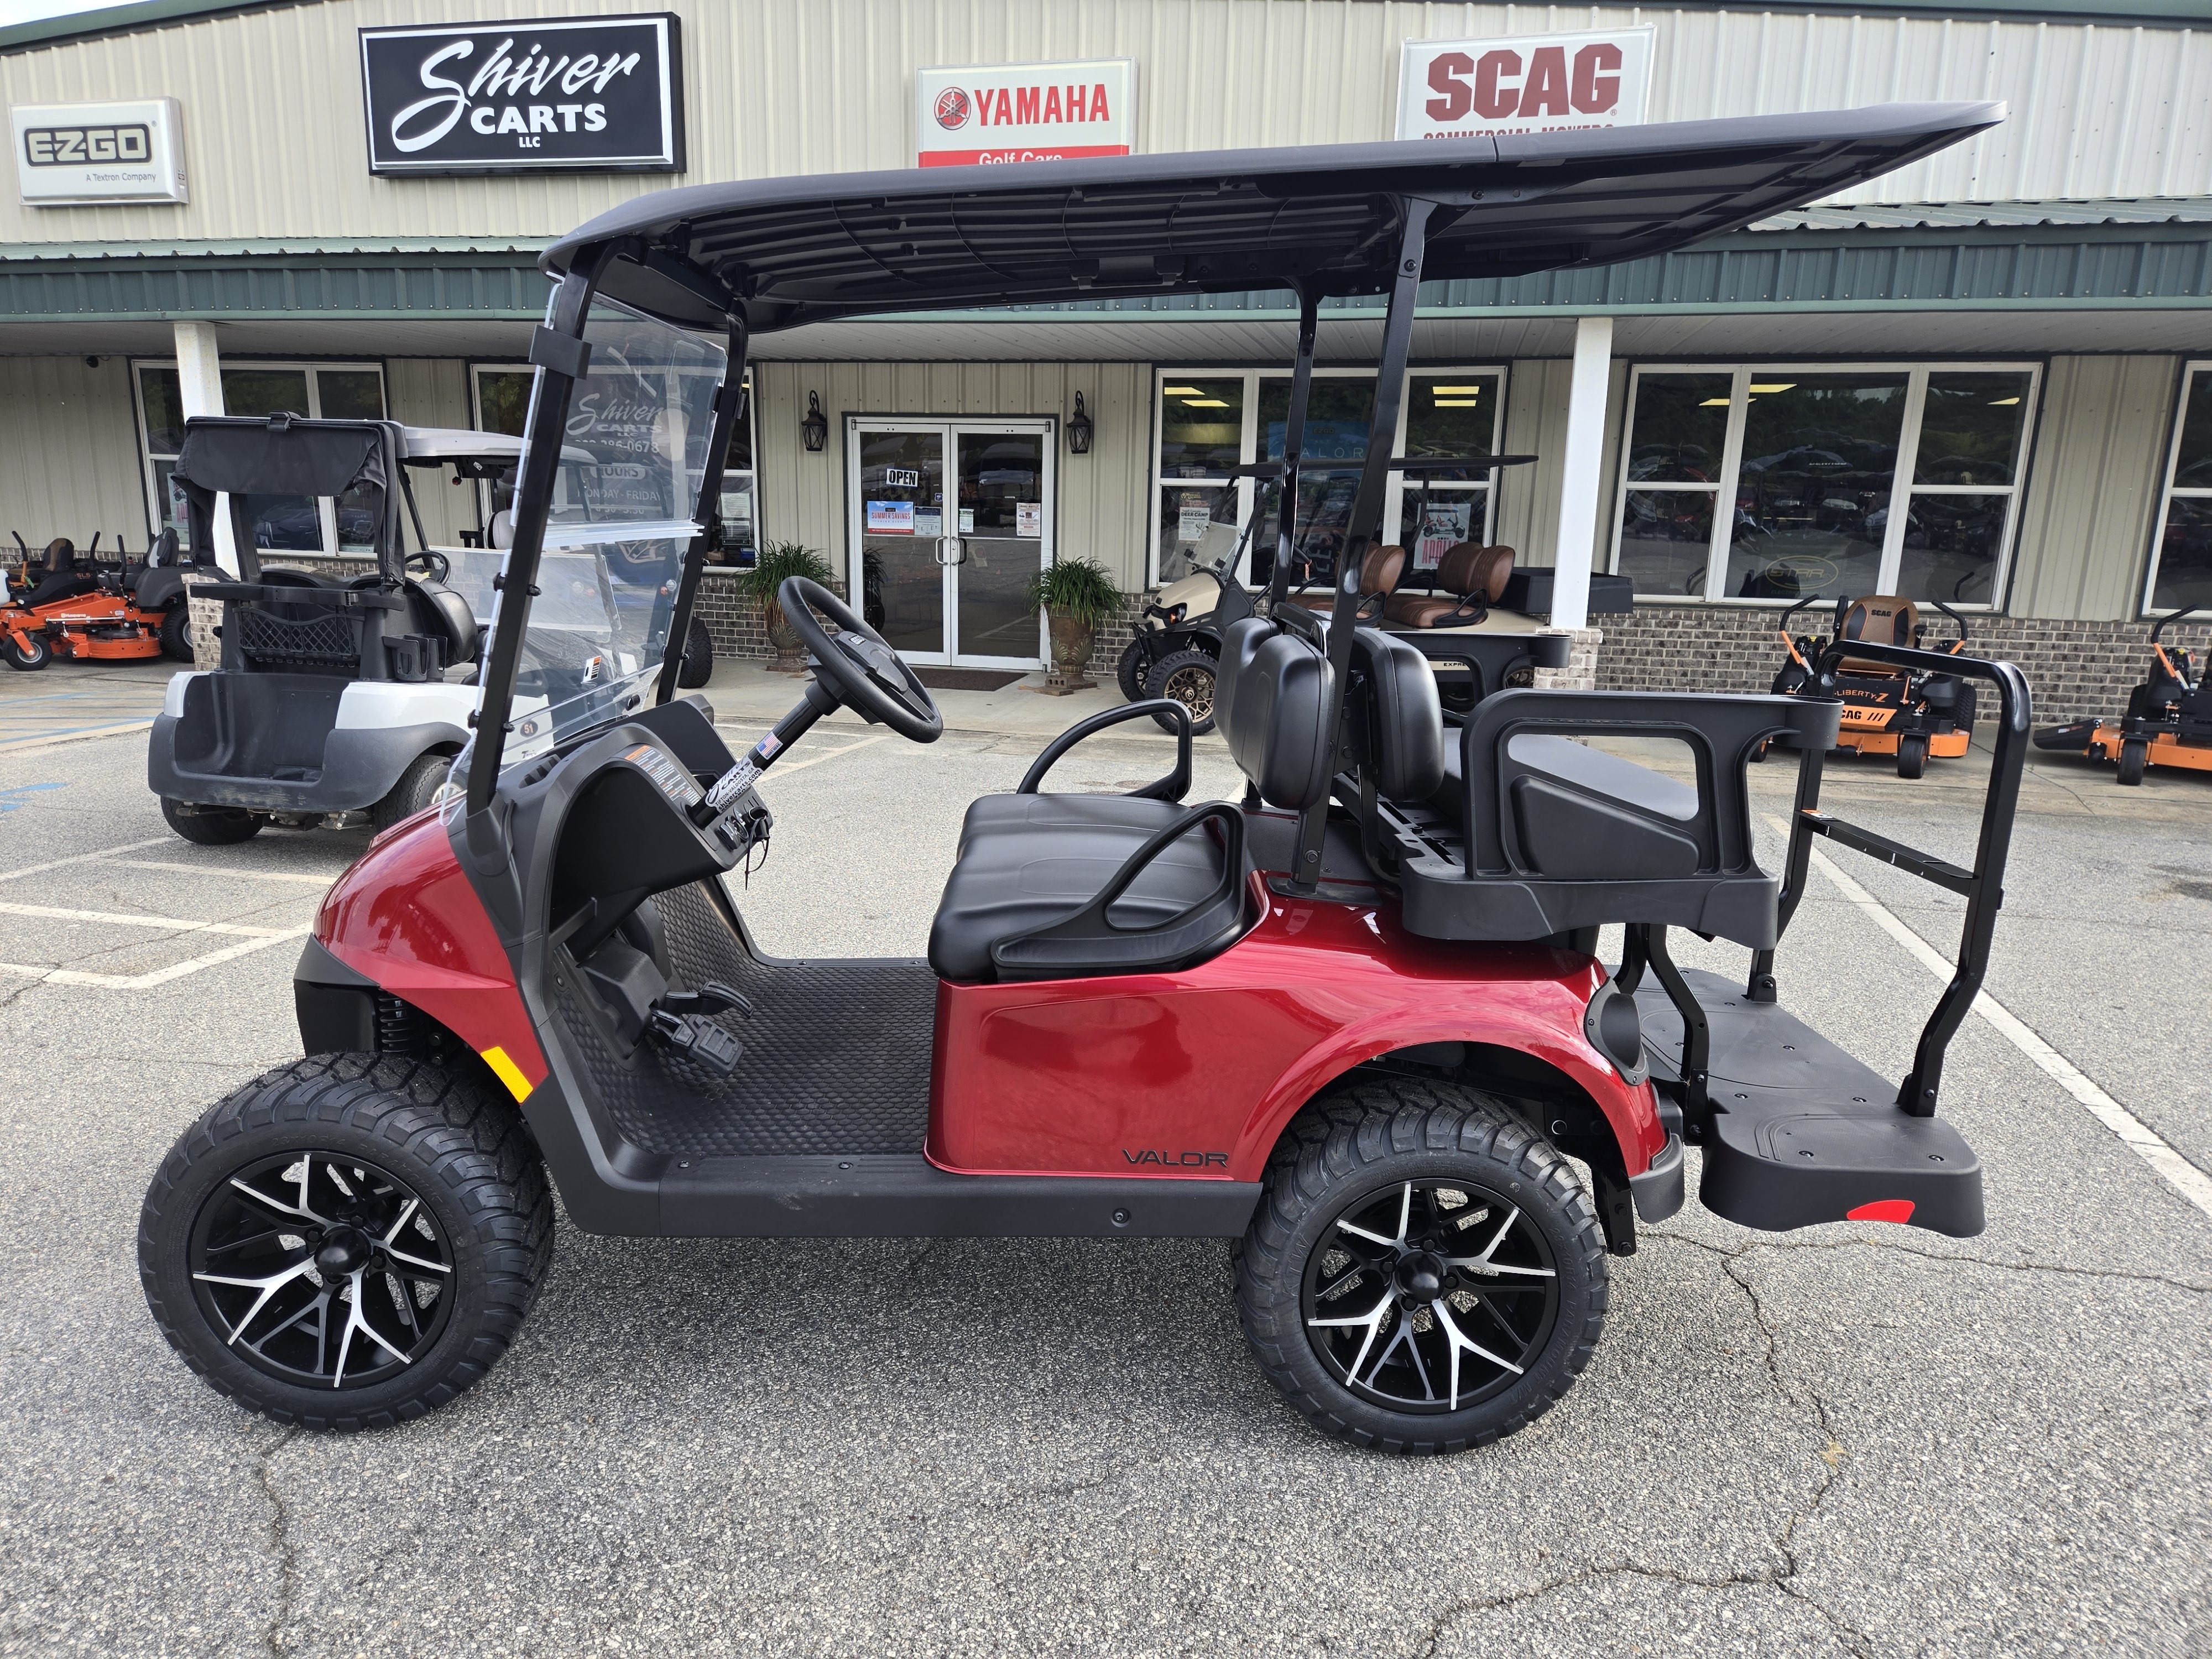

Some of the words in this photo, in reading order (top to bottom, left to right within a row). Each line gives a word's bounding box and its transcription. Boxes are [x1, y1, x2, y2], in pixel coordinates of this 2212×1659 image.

[1425, 43, 1623, 122] SCAG
[392, 39, 640, 153] Shiver
[974, 84, 1110, 127] YAMAHA
[471, 103, 607, 134] CARTS
[29, 128, 147, 163] EZGO
[519, 137, 541, 148] LLC
[979, 152, 1015, 165] Golf
[86, 174, 91, 182] A
[122, 172, 156, 182] Company
[566, 393, 664, 436] Shiver
[596, 424, 662, 433] CARTS
[1300, 447, 1364, 458] ALOR
[601, 467, 639, 477] OURS
[889, 470, 916, 486] OPEN
[577, 488, 620, 498] ONDAY
[1421, 539, 1460, 564] APO
[1770, 568, 1824, 578] STAR
[1871, 609, 1892, 617] SCAG
[1837, 689, 1876, 699] LIBERTY
[1841, 709, 1862, 719] CAG
[524, 723, 534, 734] 51
[721, 760, 751, 790] CARTS
[718, 769, 760, 810] shivercarts.com
[1122, 1148, 1229, 1168] VALOR
